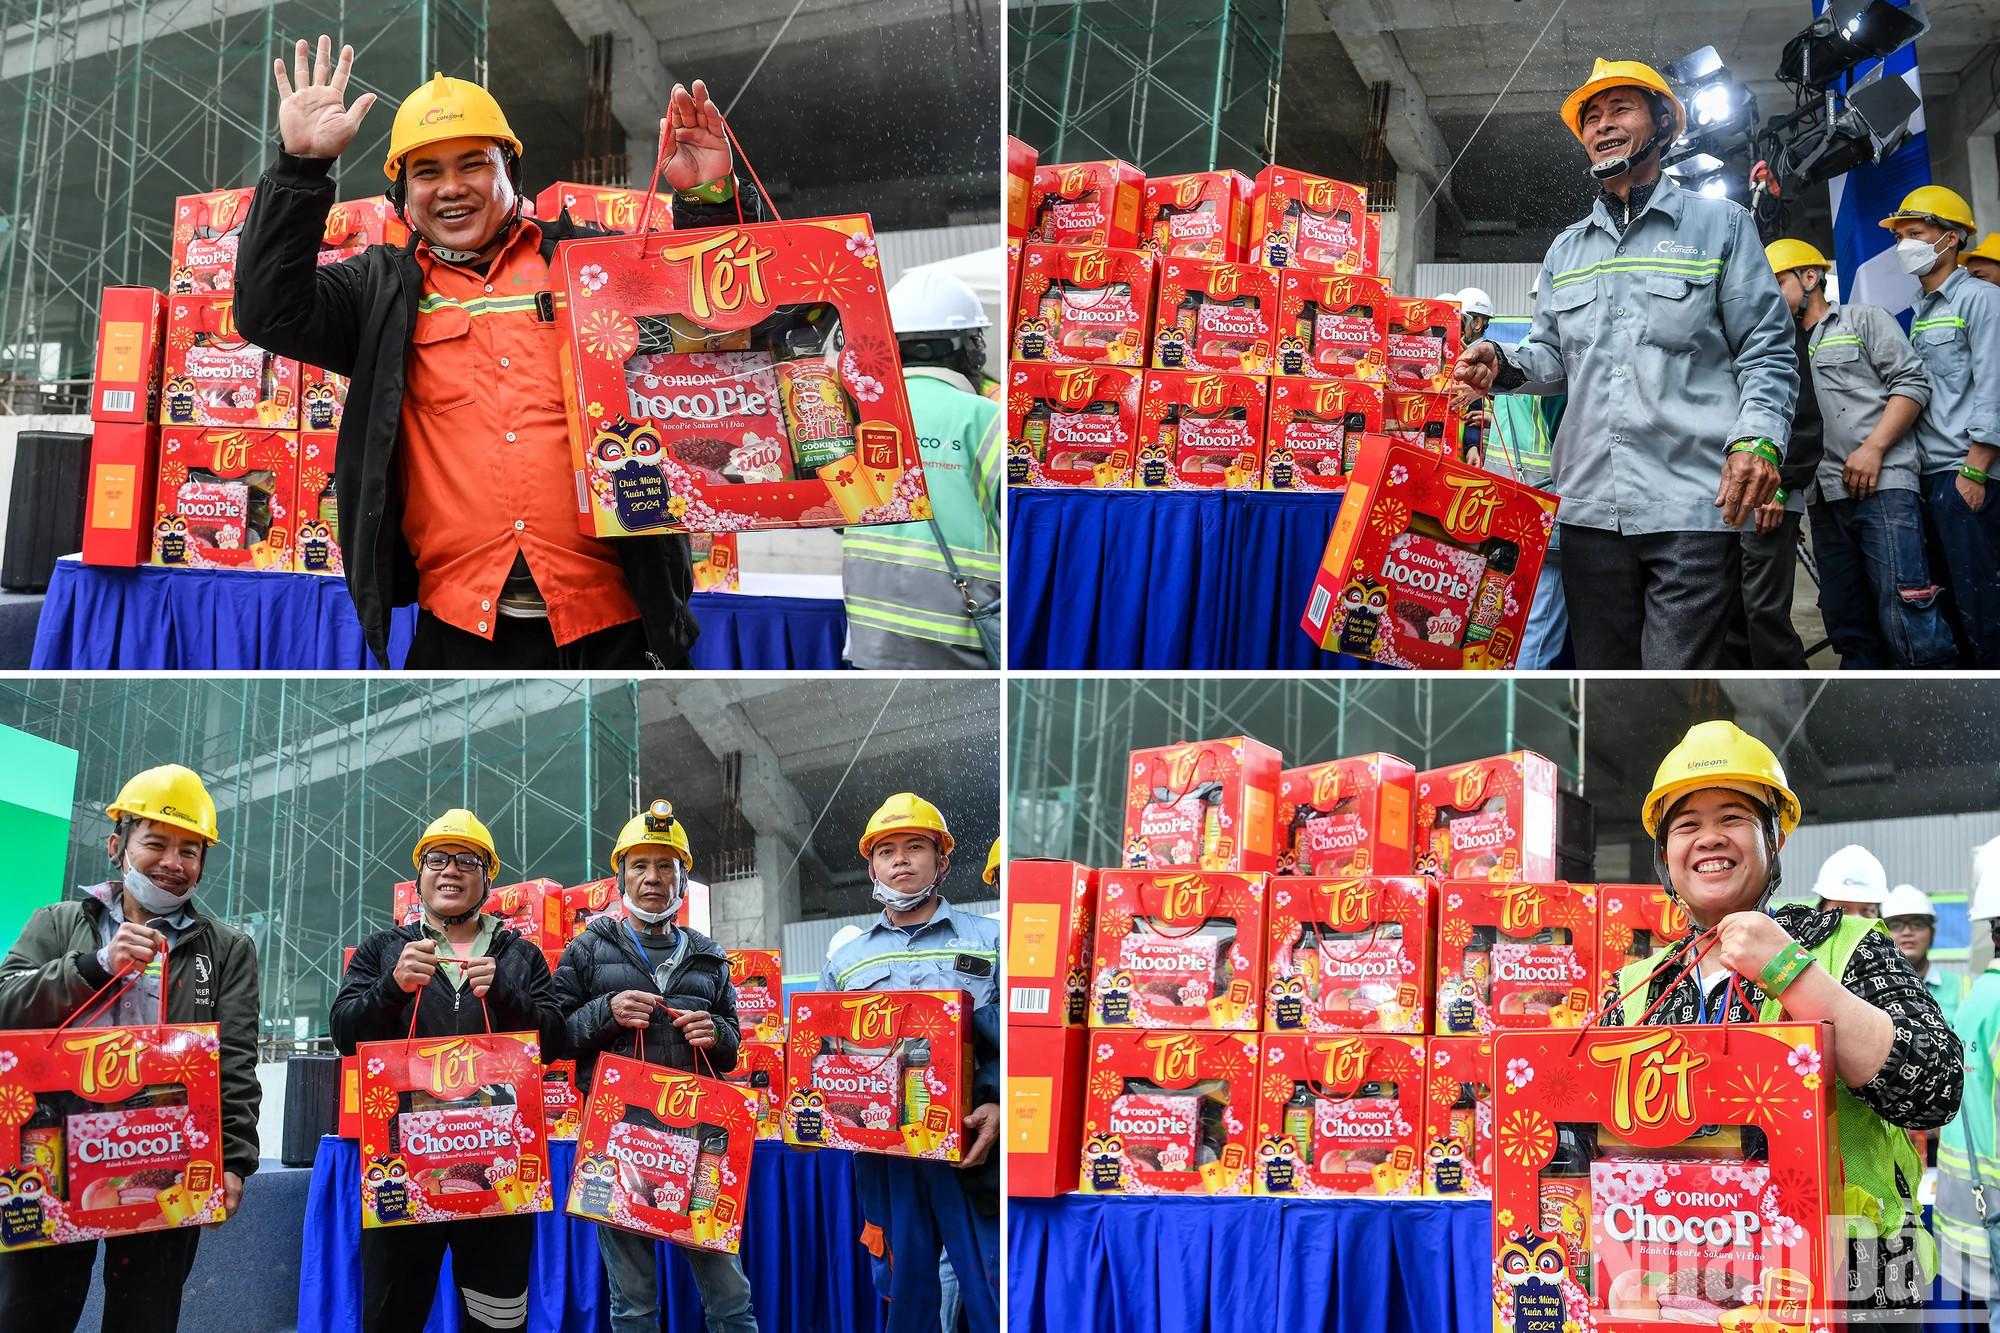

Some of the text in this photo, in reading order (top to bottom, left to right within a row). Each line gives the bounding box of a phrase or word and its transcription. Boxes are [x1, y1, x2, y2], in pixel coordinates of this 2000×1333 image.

[1057, 164, 1086, 195] Tết
[1170, 176, 1201, 206] Tết
[1302, 179, 1336, 207] Tết
[598, 191, 641, 227] Tết
[186, 249, 230, 267] hocoPie
[1066, 249, 1112, 283] Tết
[664, 230, 773, 318] Tết
[1200, 262, 1244, 296] Tết
[1318, 275, 1357, 307] Tết
[1399, 300, 1433, 327] Tết
[662, 374, 717, 387] ORION
[1052, 366, 1100, 401] Tết
[1184, 374, 1229, 408] Tết
[627, 384, 768, 421] hocoPie
[1309, 381, 1349, 414] Tết
[1398, 394, 1430, 423] Tết
[661, 421, 691, 430] hocoPie
[693, 421, 718, 430] Sakura
[730, 421, 745, 429] Đào
[206, 431, 254, 472] Tết
[801, 440, 841, 451] COOKING
[866, 443, 894, 464] Tết
[1284, 436, 1336, 451] hocoPie
[737, 446, 777, 473] Đào
[618, 476, 662, 489] Chúc Mừng
[623, 486, 662, 499] Xuân Mới
[177, 500, 240, 518] hocoPie
[630, 499, 661, 512] 2024
[1446, 474, 1504, 534] Tết
[1411, 553, 1446, 571] ORION
[1380, 554, 1470, 602] hocoPie
[1430, 619, 1457, 634] Đào
[1687, 758, 1728, 770] Unicons
[1310, 764, 1343, 804] Tết
[1449, 764, 1484, 806] Tết
[1140, 816, 1191, 837] hocoPie
[584, 881, 609, 908] Tết
[1153, 872, 1213, 920] Tết
[1318, 877, 1376, 928] Tết
[1491, 884, 1548, 930] Tết
[1151, 946, 1182, 955] ORION
[1534, 956, 1563, 965] ORION
[1181, 985, 1206, 1003] Đào
[841, 993, 901, 1041] Tết
[66, 1029, 149, 1094] Tết
[418, 1037, 483, 1093] Tết
[1145, 1033, 1206, 1082] Tết
[1314, 1036, 1372, 1085] Tết
[811, 1072, 888, 1095] hocoPie
[1591, 1031, 1706, 1131] Tết
[651, 1073, 708, 1119] Tết
[448, 1121, 482, 1131] ORION
[864, 1110, 889, 1124] Đào
[1110, 1115, 1187, 1135] hocoPie
[1131, 1108, 1161, 1117] ORION
[1356, 1112, 1389, 1120] ORION
[131, 1122, 173, 1135] ORION
[606, 1139, 687, 1175] hocoPie
[633, 1138, 663, 1152] ORION
[1161, 1151, 1187, 1167] Đào
[657, 1190, 681, 1203] Đào
[1675, 1191, 1738, 1208] ORION
[1603, 1202, 1770, 1249] ChocoP
[1640, 1245, 1765, 1262] Bánh ChocoPie Sakura Vị Đào
[1519, 1294, 1560, 1307] Chúc Mừng
[1521, 1306, 1559, 1317] Xuân Mới
[1774, 1294, 1803, 1321] Tết
[1527, 1320, 1556, 1331] 2024
